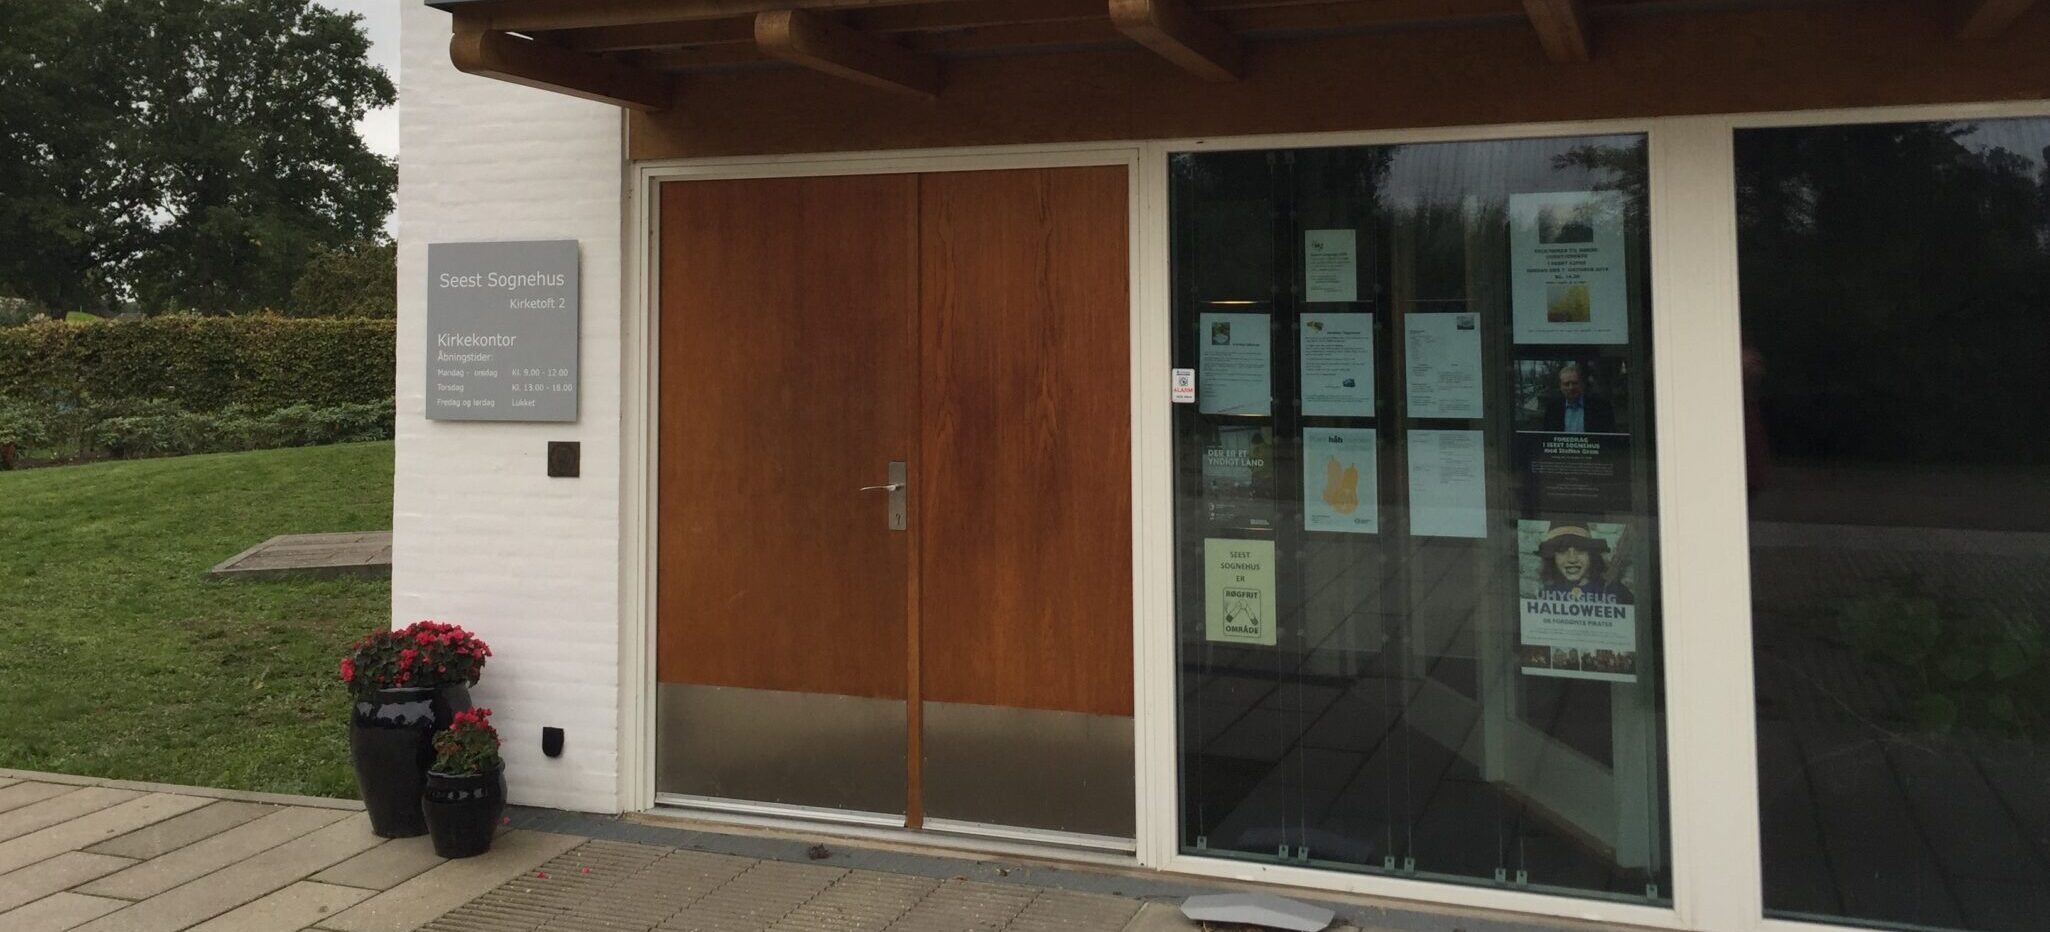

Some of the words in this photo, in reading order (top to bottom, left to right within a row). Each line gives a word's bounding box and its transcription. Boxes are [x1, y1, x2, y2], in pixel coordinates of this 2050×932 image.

[439, 273, 483, 288] Seest
[487, 271, 565, 290] Sognehus
[510, 298, 556, 309] Kirketoft
[558, 298, 566, 309] 2
[437, 333, 517, 347] Kirkekontor
[437, 350, 494, 364] Åbningstider:
[438, 369, 465, 378] Mandag
[474, 369, 498, 378] onsdag
[523, 368, 541, 377] 9.00
[548, 368, 569, 377] 12.00
[437, 383, 465, 392] Torsdag
[437, 398, 461, 408] Fredag
[462, 400, 472, 408] og
[473, 398, 496, 408] lørdag
[512, 398, 536, 407] Lukket
[1208, 449, 1224, 457] DER
[1226, 449, 1236, 457] ER
[1238, 450, 1248, 458] ET
[1208, 457, 1239, 466] YNDIGT
[1241, 458, 1265, 467] LAND
[1230, 551, 1250, 559] SEEST
[1220, 562, 1260, 570] SOGNEHUS
[1225, 590, 1258, 598] RØGFRIT
[1537, 590, 1617, 604] UHYGGELIG
[1527, 601, 1627, 619] HALLOWEEN
[1225, 624, 1259, 634] OMRÅDE
